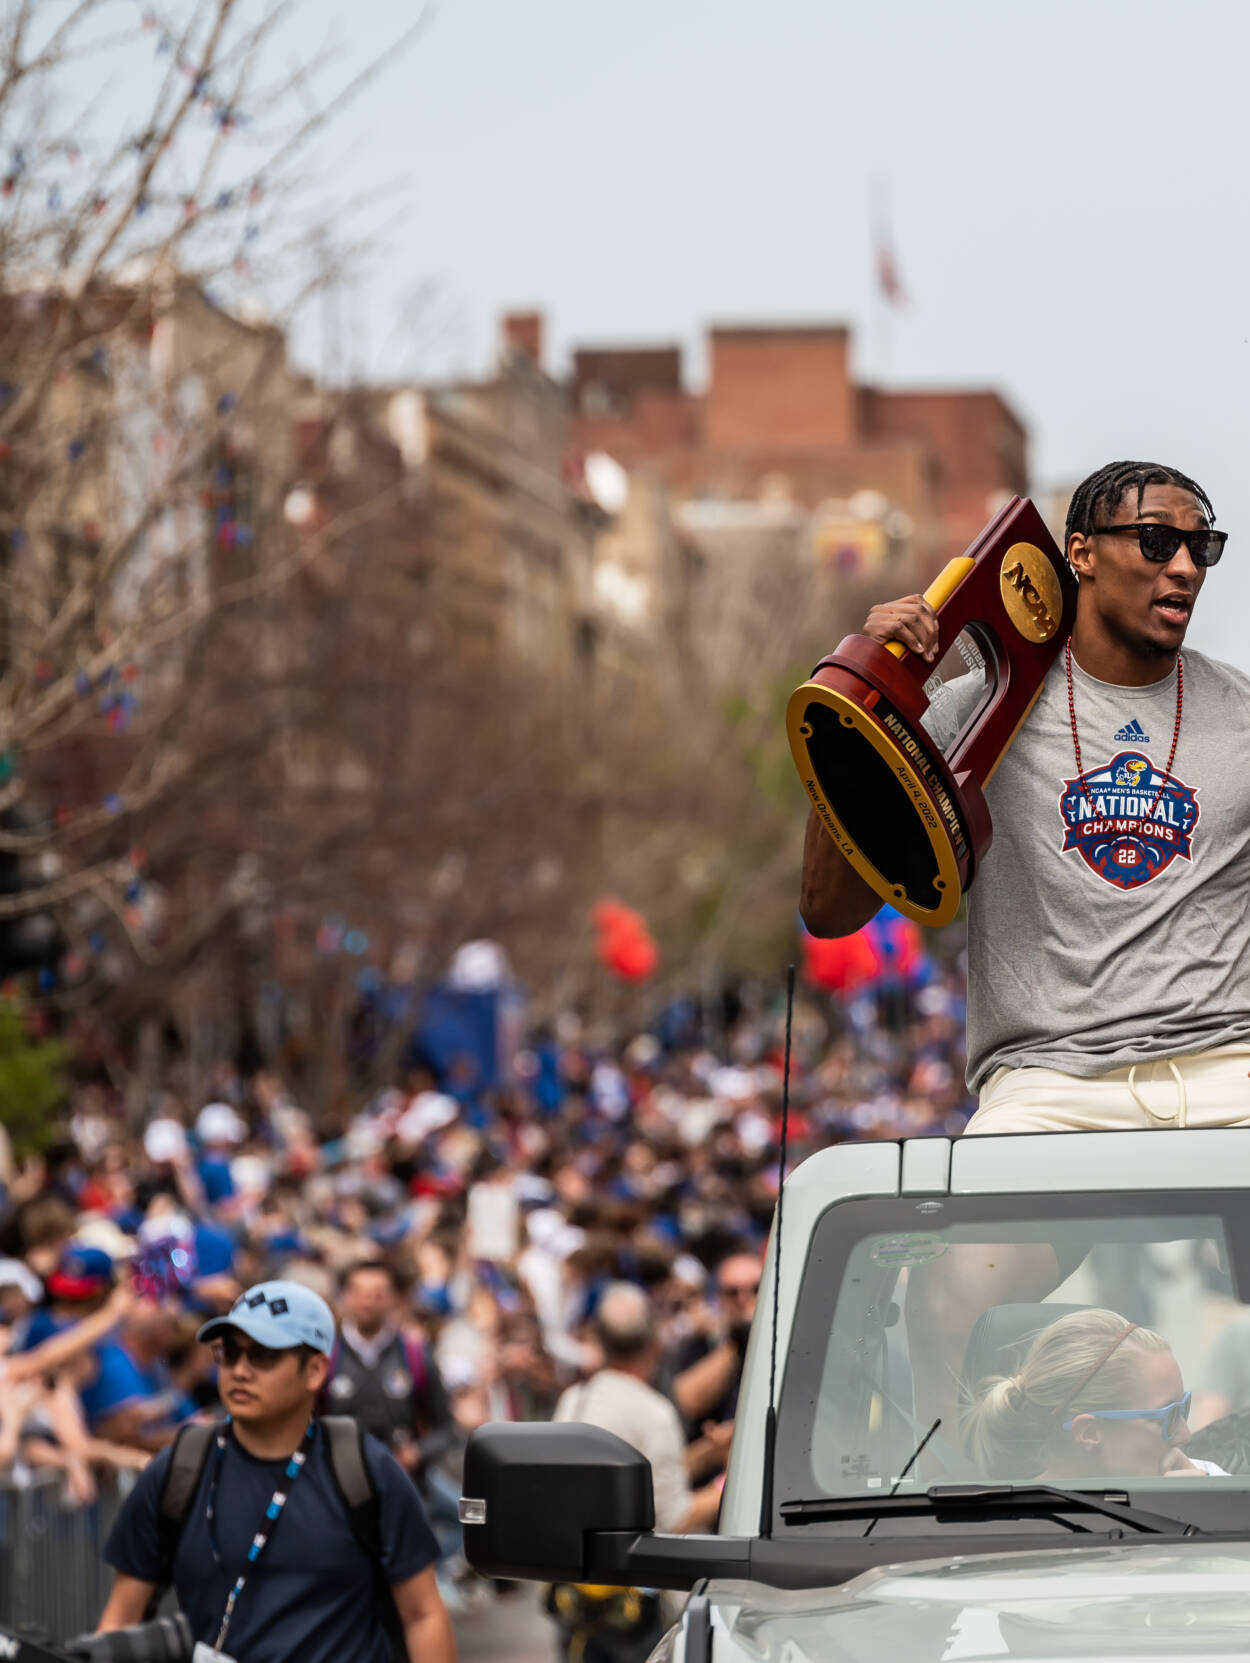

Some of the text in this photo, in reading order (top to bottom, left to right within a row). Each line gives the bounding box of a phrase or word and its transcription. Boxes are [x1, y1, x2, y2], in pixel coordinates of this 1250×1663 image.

[1002, 562, 1056, 638] NCAA
[883, 713, 932, 776] NATIONAL
[1114, 732, 1150, 743] adidas
[897, 766, 916, 790] April
[918, 801, 938, 829] 2022
[1112, 787, 1130, 795] MEN'S
[1131, 788, 1171, 799] BASKETBLL
[806, 779, 820, 801] New
[841, 842, 854, 856] LA
[1078, 796, 1180, 829] NATIONAL
[1083, 820, 1174, 841] CHAMPIONS
[1118, 849, 1136, 864] 22
